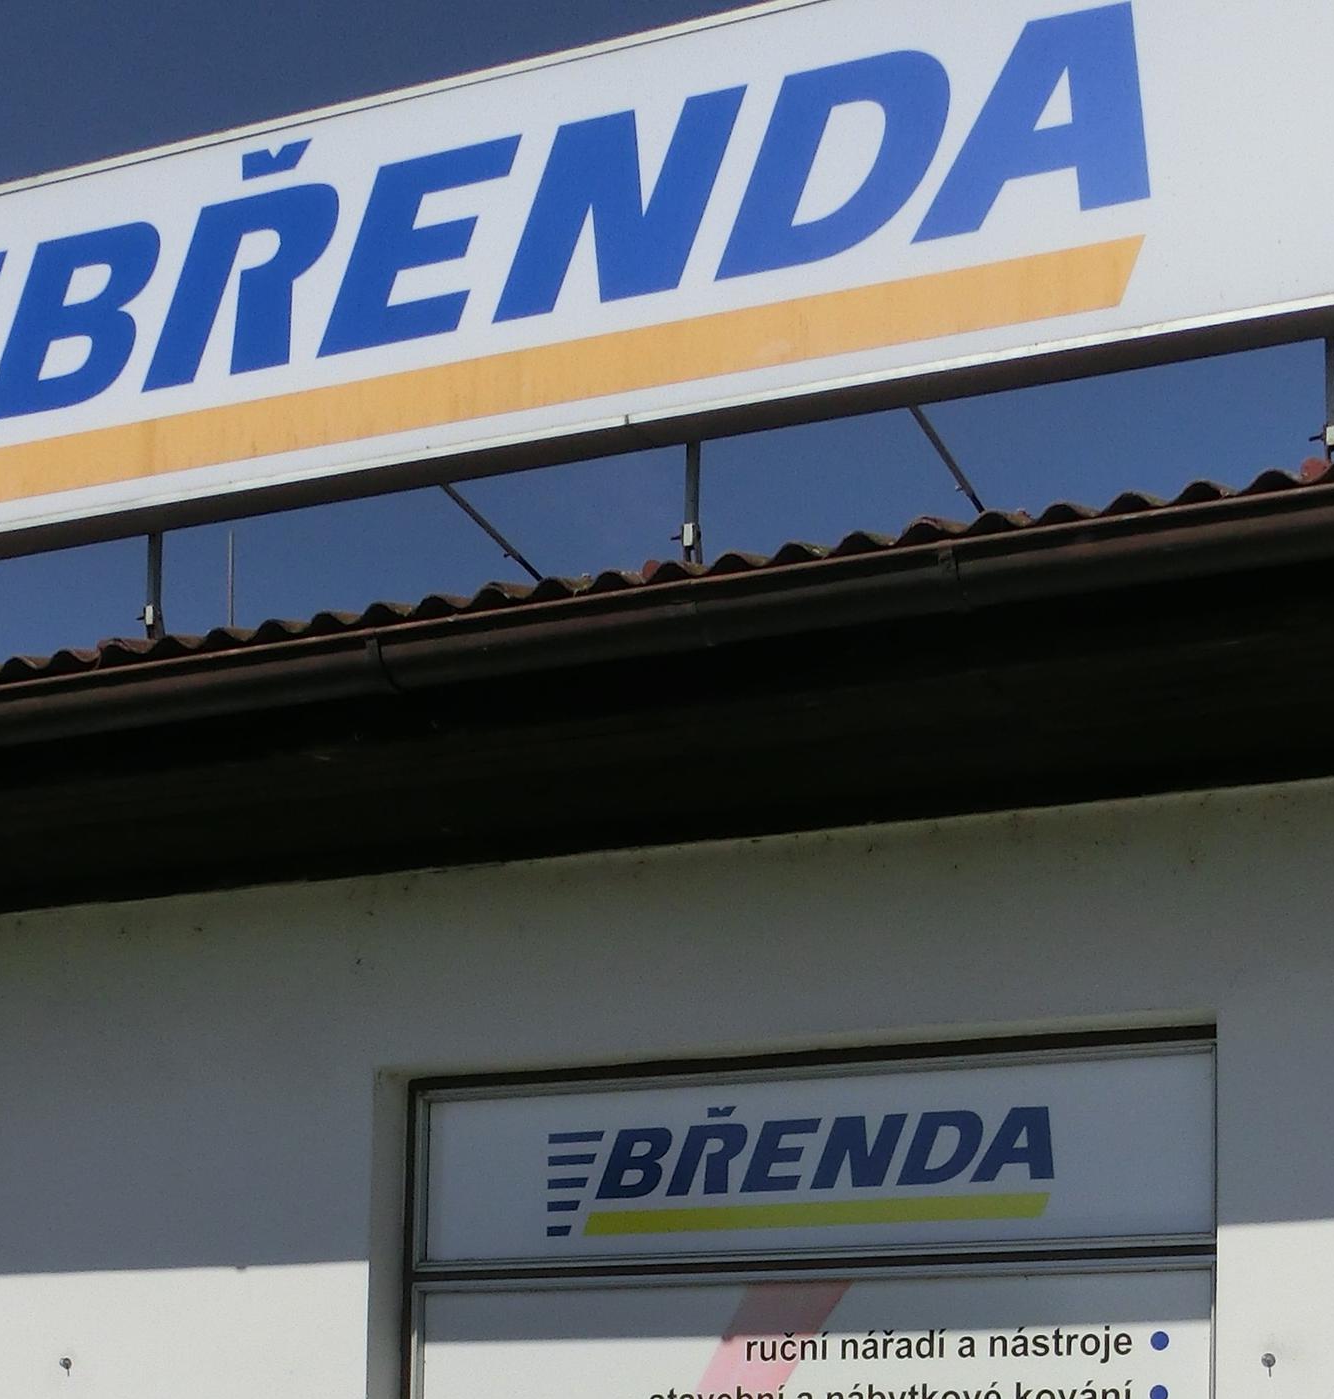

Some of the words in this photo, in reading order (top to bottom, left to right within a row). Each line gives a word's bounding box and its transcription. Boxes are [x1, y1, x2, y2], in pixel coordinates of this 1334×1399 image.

[595, 1105, 1055, 1200] BŘENDA
[745, 1331, 828, 1362] ruční
[840, 1328, 948, 1360] nářadí
[957, 1335, 976, 1358] a
[989, 1325, 1133, 1364] nástroje
